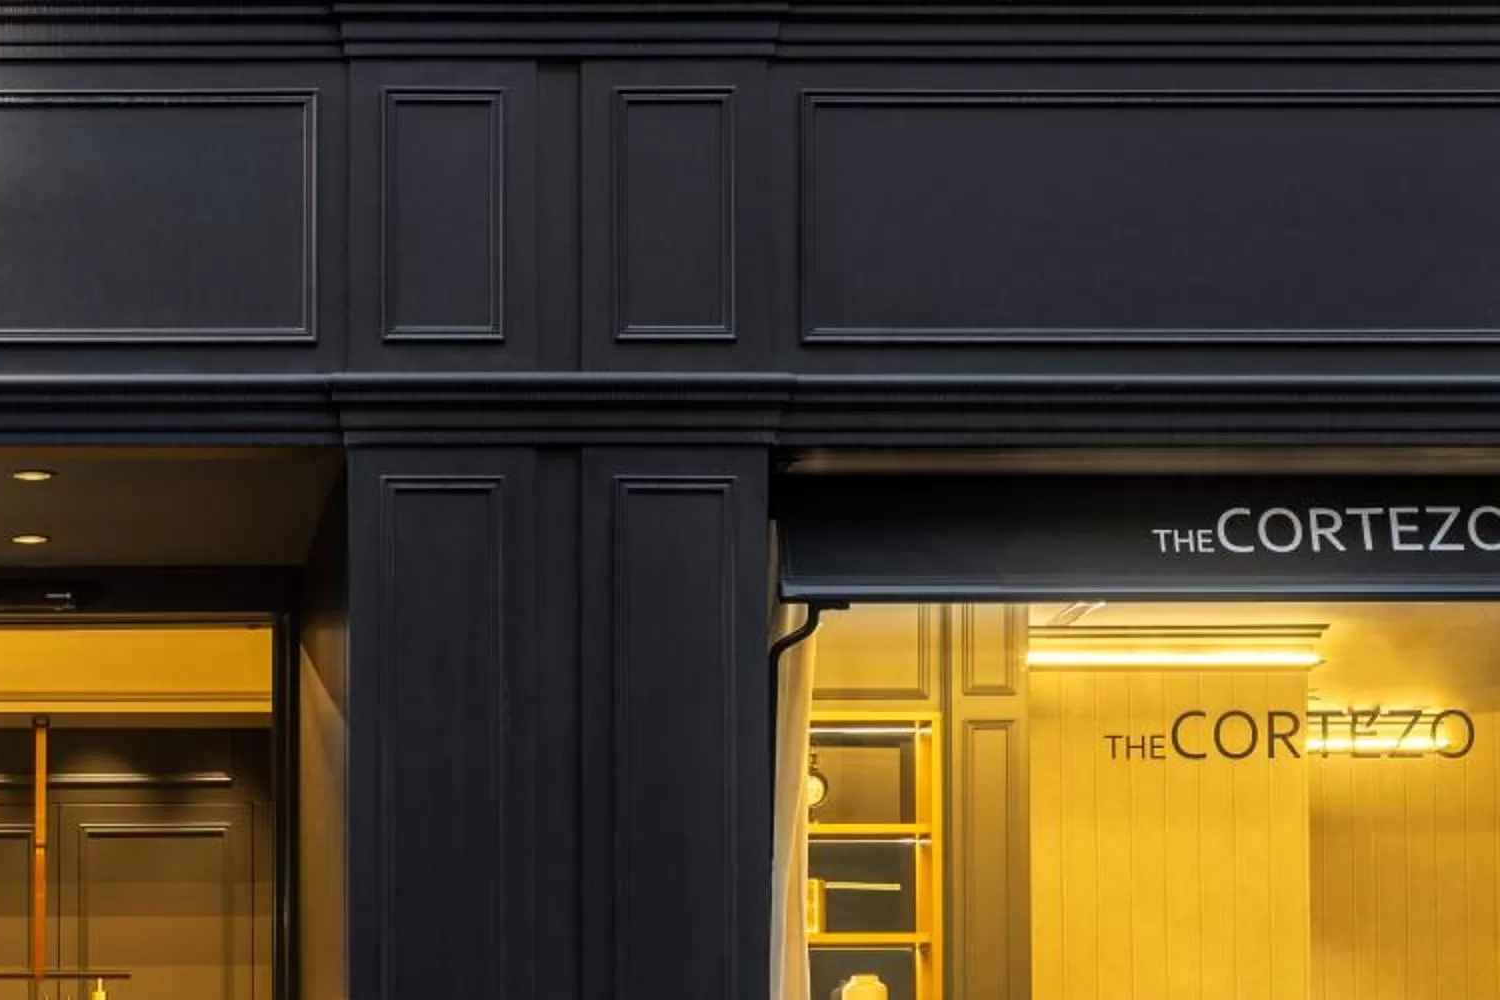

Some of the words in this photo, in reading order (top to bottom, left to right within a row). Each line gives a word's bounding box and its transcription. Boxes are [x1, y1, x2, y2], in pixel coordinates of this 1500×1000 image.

[1152, 529, 1215, 553] THE
[1216, 507, 1500, 552] CORTEZO
[1104, 735, 1166, 760] THE
[1171, 709, 1475, 759] CORTEZO
